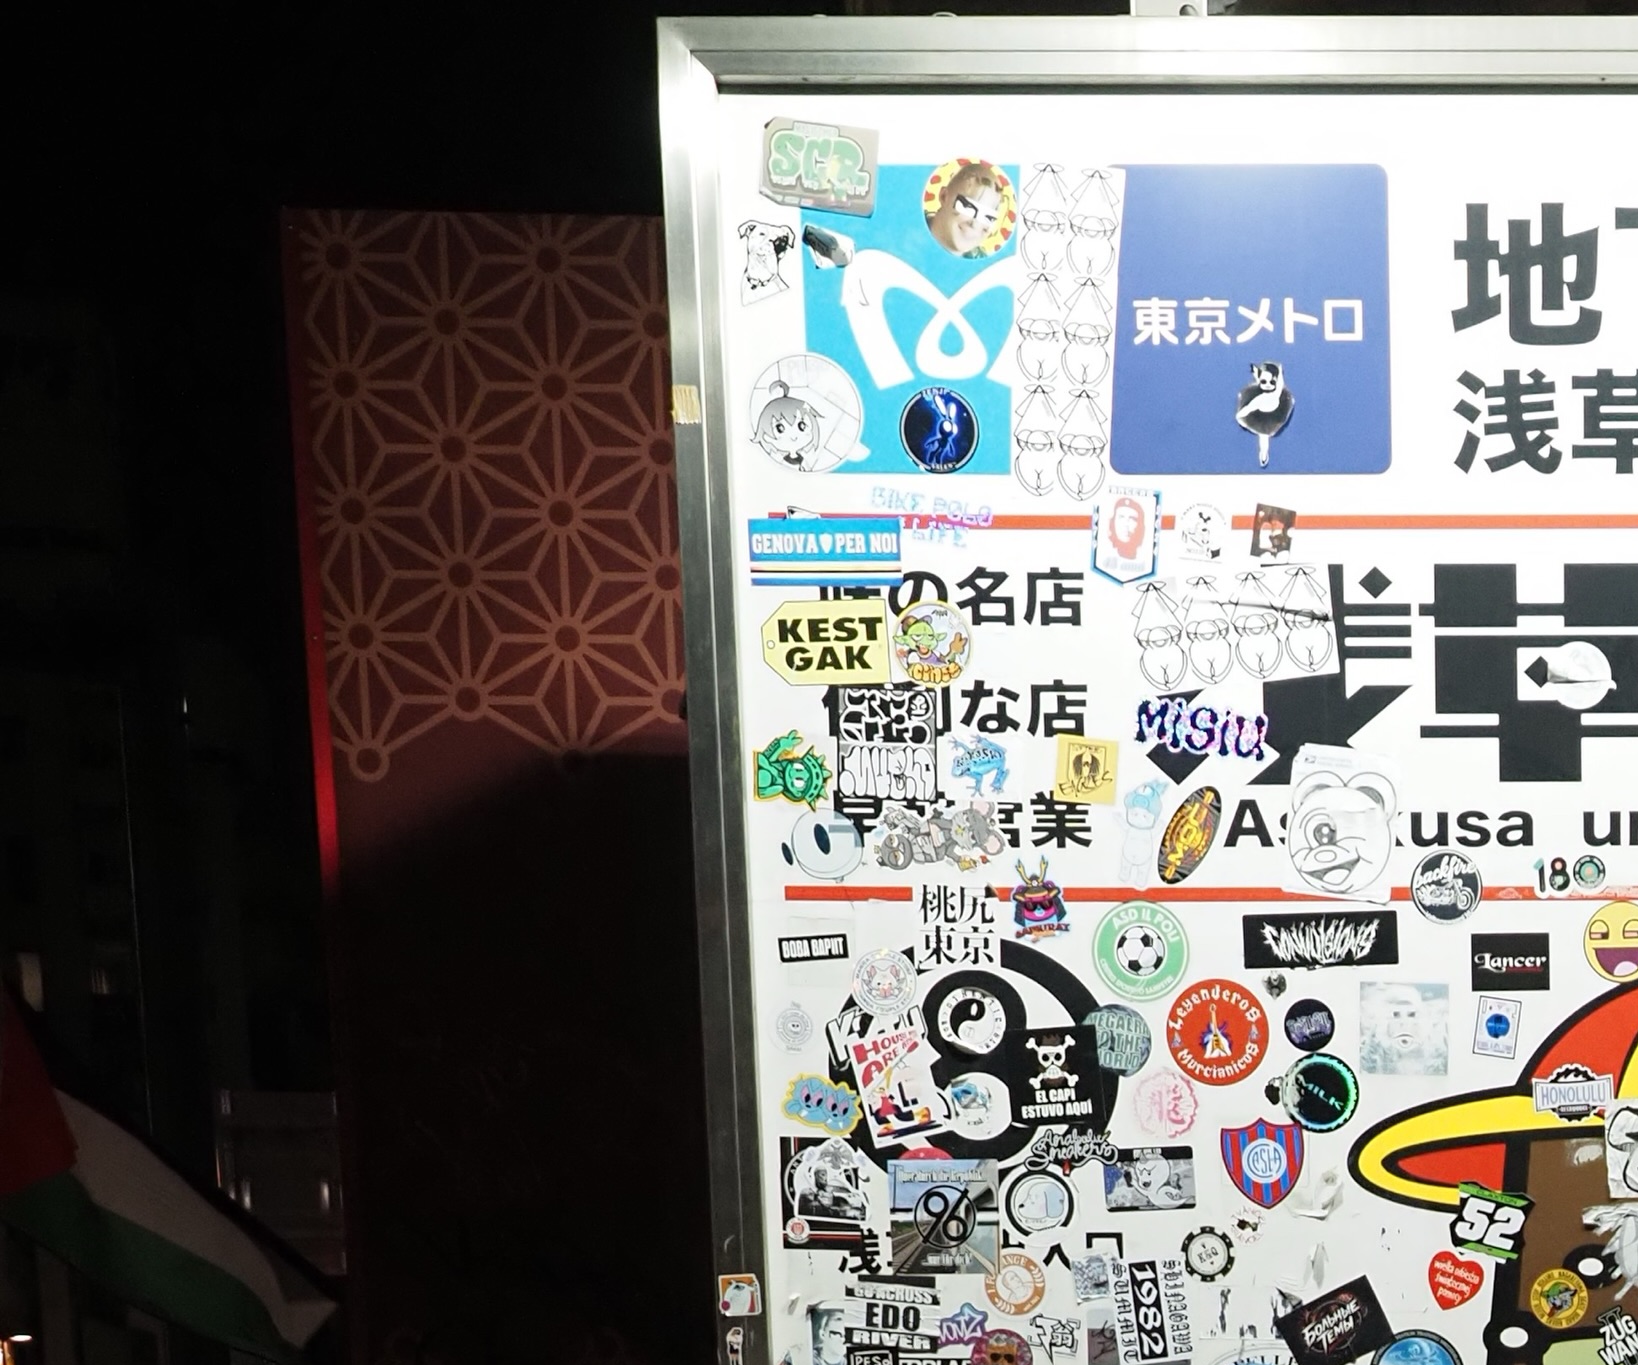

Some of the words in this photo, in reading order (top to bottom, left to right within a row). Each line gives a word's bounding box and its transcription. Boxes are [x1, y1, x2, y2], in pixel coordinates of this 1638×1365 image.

[1132, 296, 1366, 347] 東京メトロ
[751, 533, 818, 556] GENOVA
[837, 533, 865, 553] PER
[869, 532, 899, 553] NOI
[777, 616, 883, 643] KEST
[785, 645, 873, 671] GAK
[1223, 798, 1535, 849] Ausa
[919, 883, 995, 925] 桃尻
[1112, 911, 1138, 931] ASD
[1155, 907, 1184, 943] POLI
[919, 925, 995, 966] 東京
[1473, 951, 1547, 971] Lancer
[1035, 1090, 1048, 1103] EL
[1049, 1088, 1076, 1103] CAPI
[1299, 1072, 1345, 1112] MILK
[1540, 1080, 1608, 1105] HONOLULU
[1020, 1102, 1064, 1119] ESTUVO
[1453, 1195, 1525, 1249] 52
[865, 1301, 921, 1332] EDO
[1129, 1260, 1167, 1360] 1982
[1301, 1298, 1361, 1344] БОЛЬНЫЕ
[852, 1329, 932, 1350] RIVER
[1316, 1317, 1355, 1351] ТЕМЫ
[1599, 1313, 1637, 1346] ZUG
